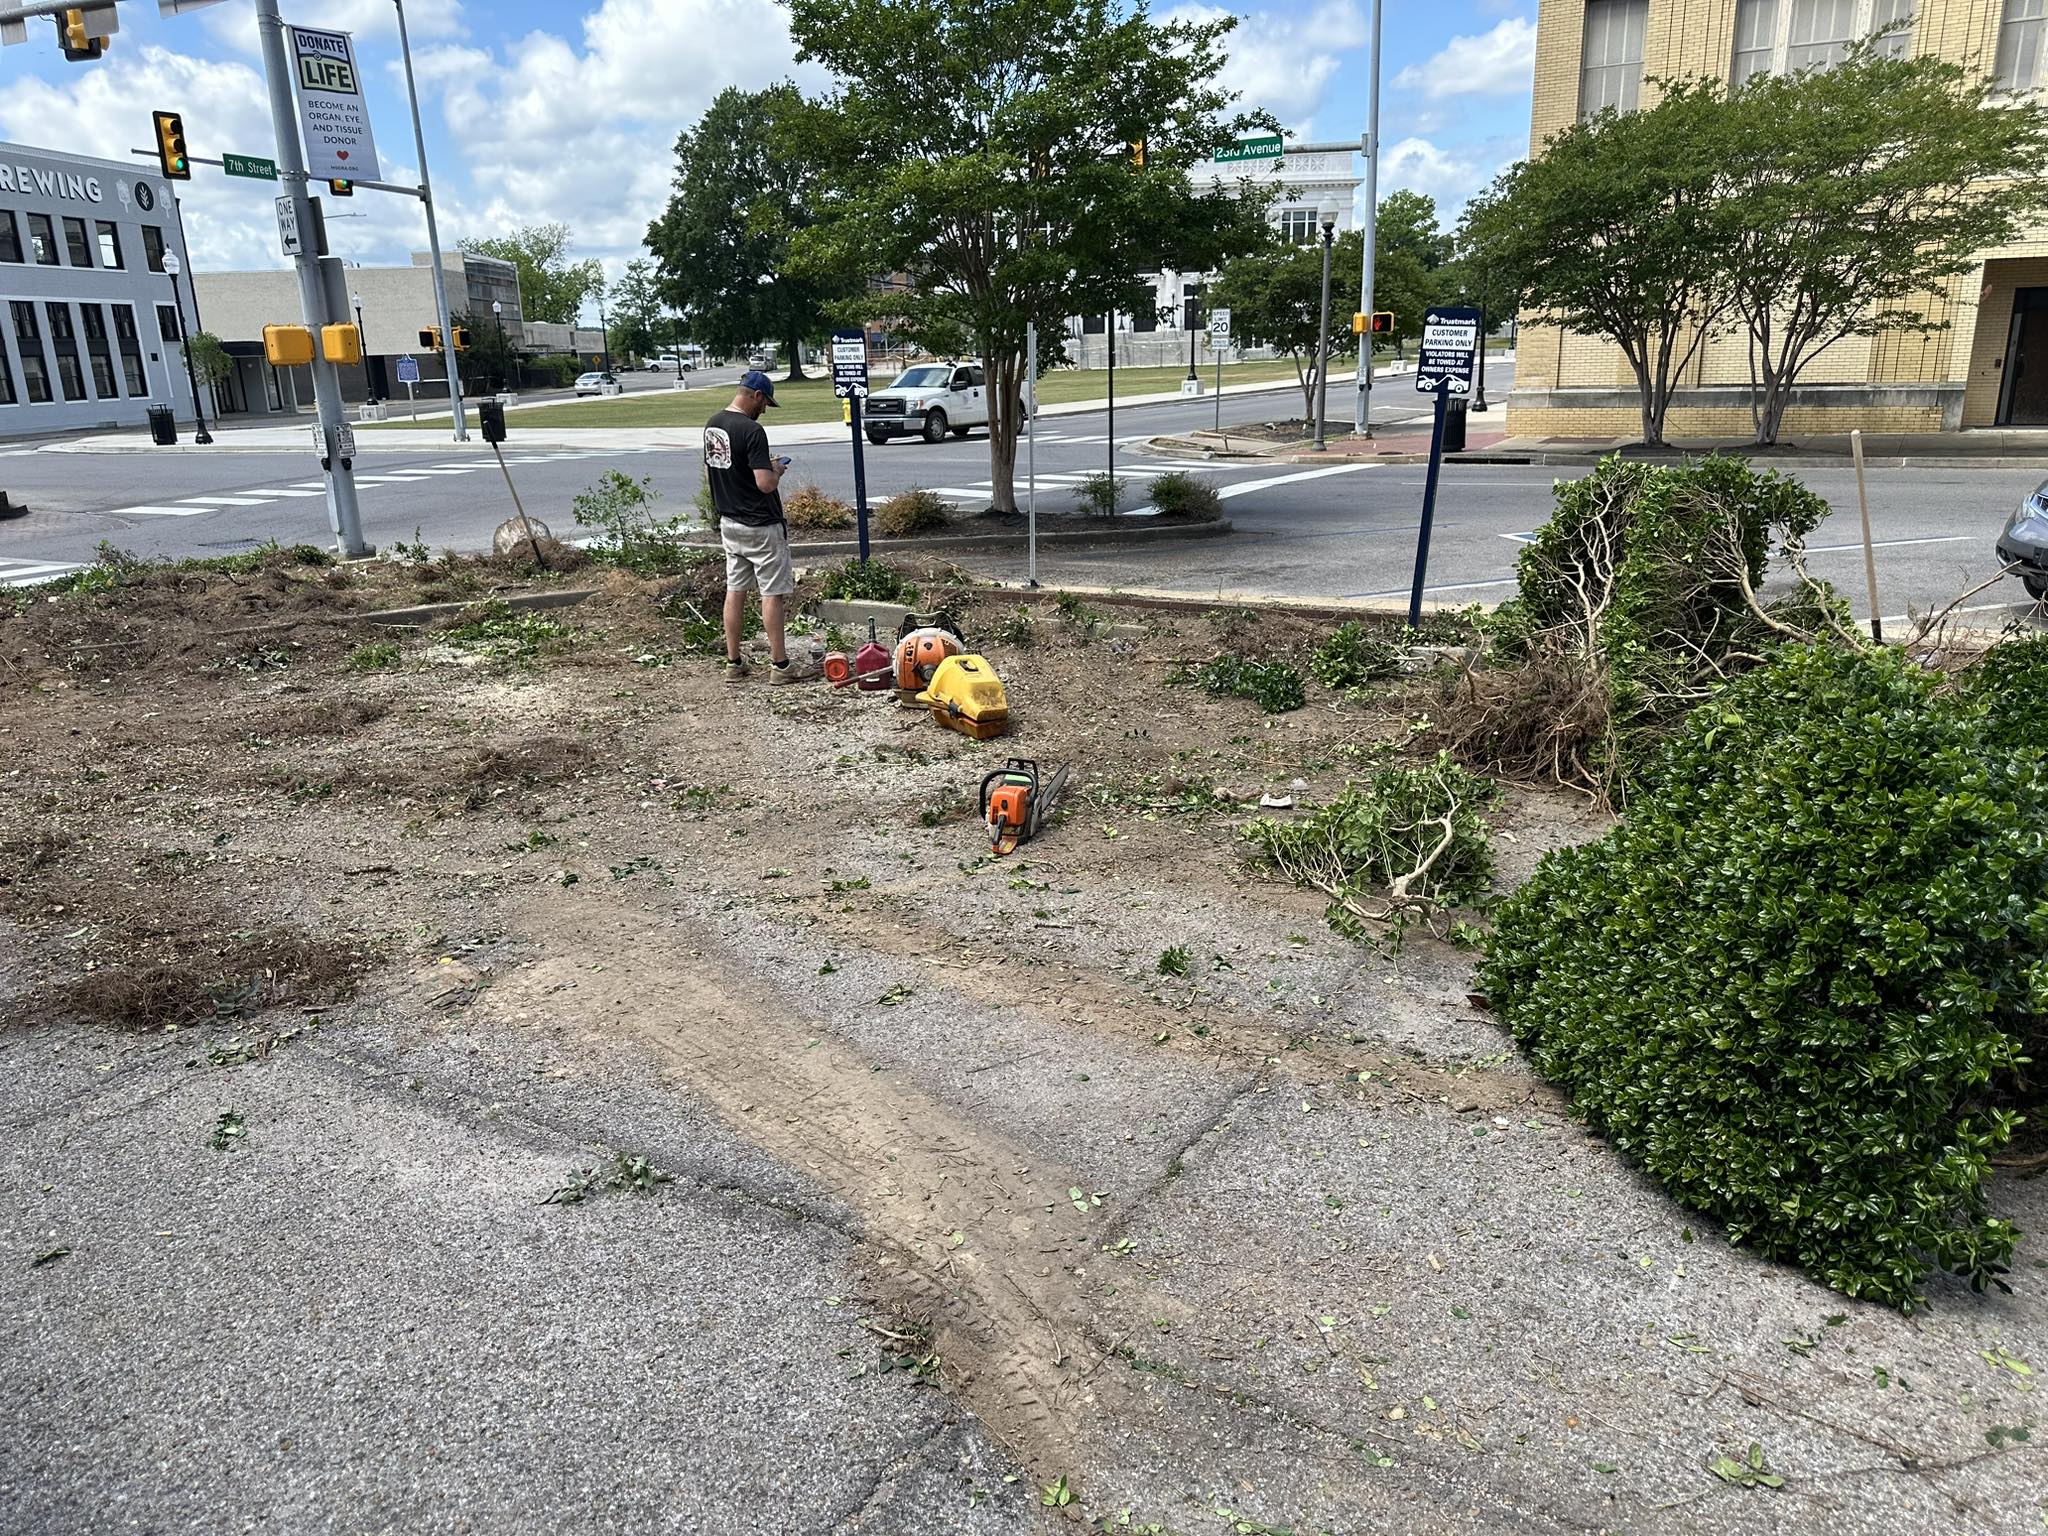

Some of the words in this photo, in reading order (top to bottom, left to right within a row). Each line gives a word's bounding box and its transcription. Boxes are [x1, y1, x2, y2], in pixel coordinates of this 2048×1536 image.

[298, 34, 344, 53] DONATE
[305, 60, 352, 88] LIFE
[308, 100, 345, 110] BECOME
[346, 104, 359, 112] AN
[308, 112, 344, 122] ORGAN,
[345, 115, 363, 124] EYE,
[312, 124, 333, 132] AND
[334, 125, 363, 134] TISSUE
[323, 136, 357, 145] DONOR
[1243, 143, 1281, 156] Avenue
[228, 159, 244, 172] 7th
[247, 161, 273, 175] Street
[0, 163, 103, 203] REWING
[278, 200, 293, 216] ONE
[280, 217, 295, 232] WAY
[1213, 322, 1228, 332] 20
[1440, 317, 1476, 325] Trustmark
[1432, 329, 1468, 337] CUSTOMER
[1425, 338, 1453, 346] PARKING
[1455, 339, 1472, 347] ONLY
